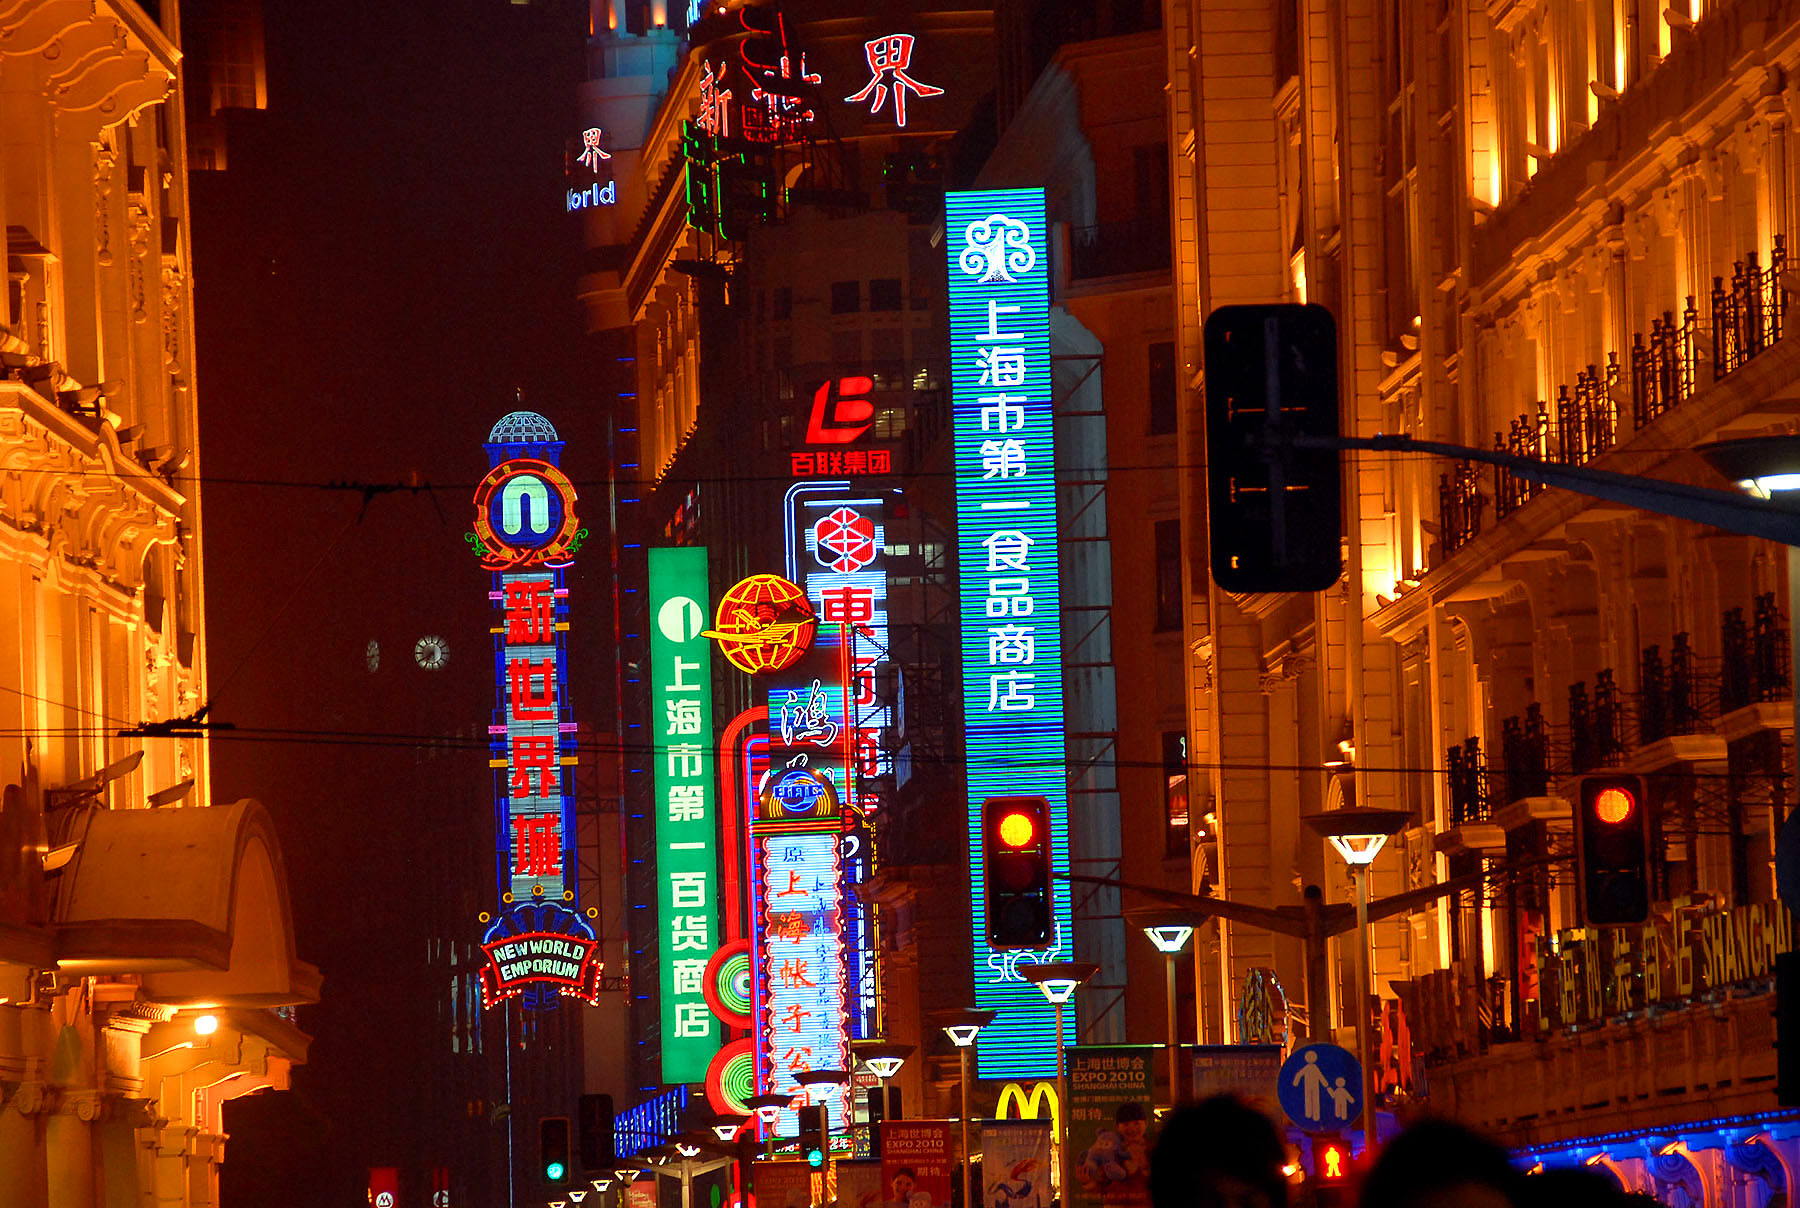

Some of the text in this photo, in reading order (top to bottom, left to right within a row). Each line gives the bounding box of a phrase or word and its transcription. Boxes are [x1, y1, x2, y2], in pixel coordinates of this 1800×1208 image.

[790, 449, 891, 476] 百联集团
[975, 299, 1036, 713] 上海市第一食品商店
[504, 579, 561, 877] 新世界城
[665, 655, 710, 1038] 上海市第一百货商店
[493, 939, 585, 963] NEW WORLD
[500, 959, 580, 981] EMPORIUM
[1072, 1071, 1146, 1082] EXPO 2010
[886, 1139, 944, 1148] EXPO 2010
